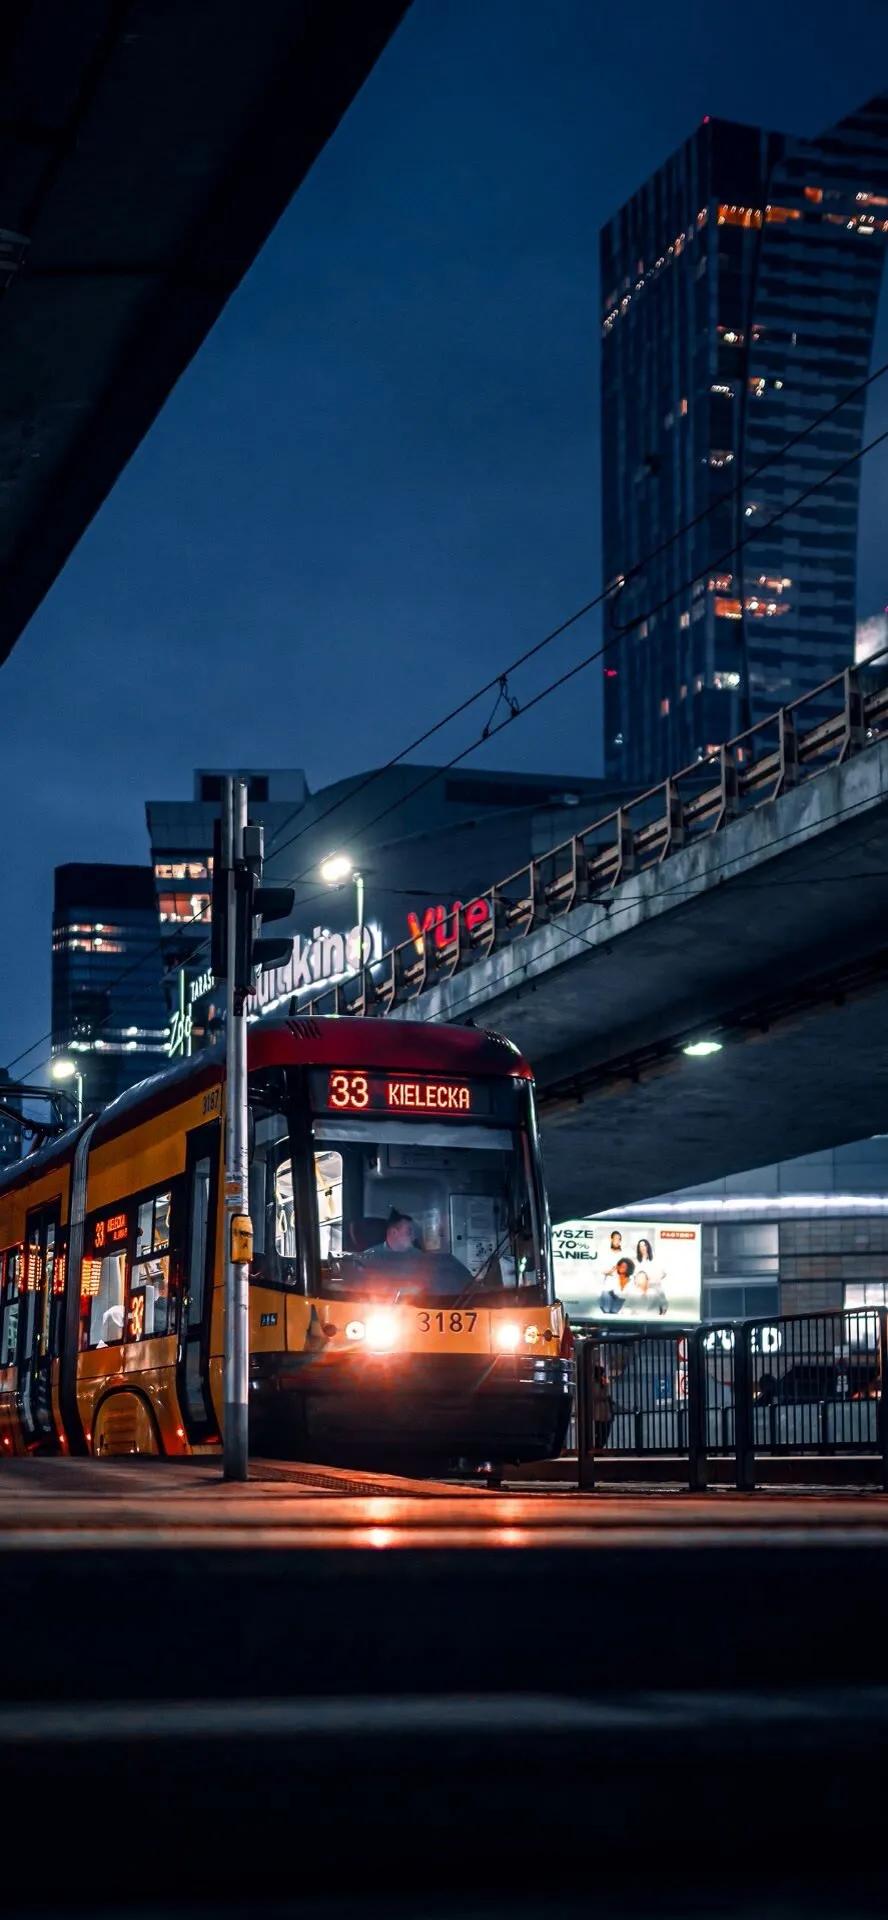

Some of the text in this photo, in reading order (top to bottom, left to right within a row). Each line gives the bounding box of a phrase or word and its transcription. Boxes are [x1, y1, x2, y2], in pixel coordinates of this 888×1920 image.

[331, 1075, 470, 1109] 33 KIELECKA
[95, 1221, 104, 1248] 33
[417, 1311, 478, 1333] 3187
